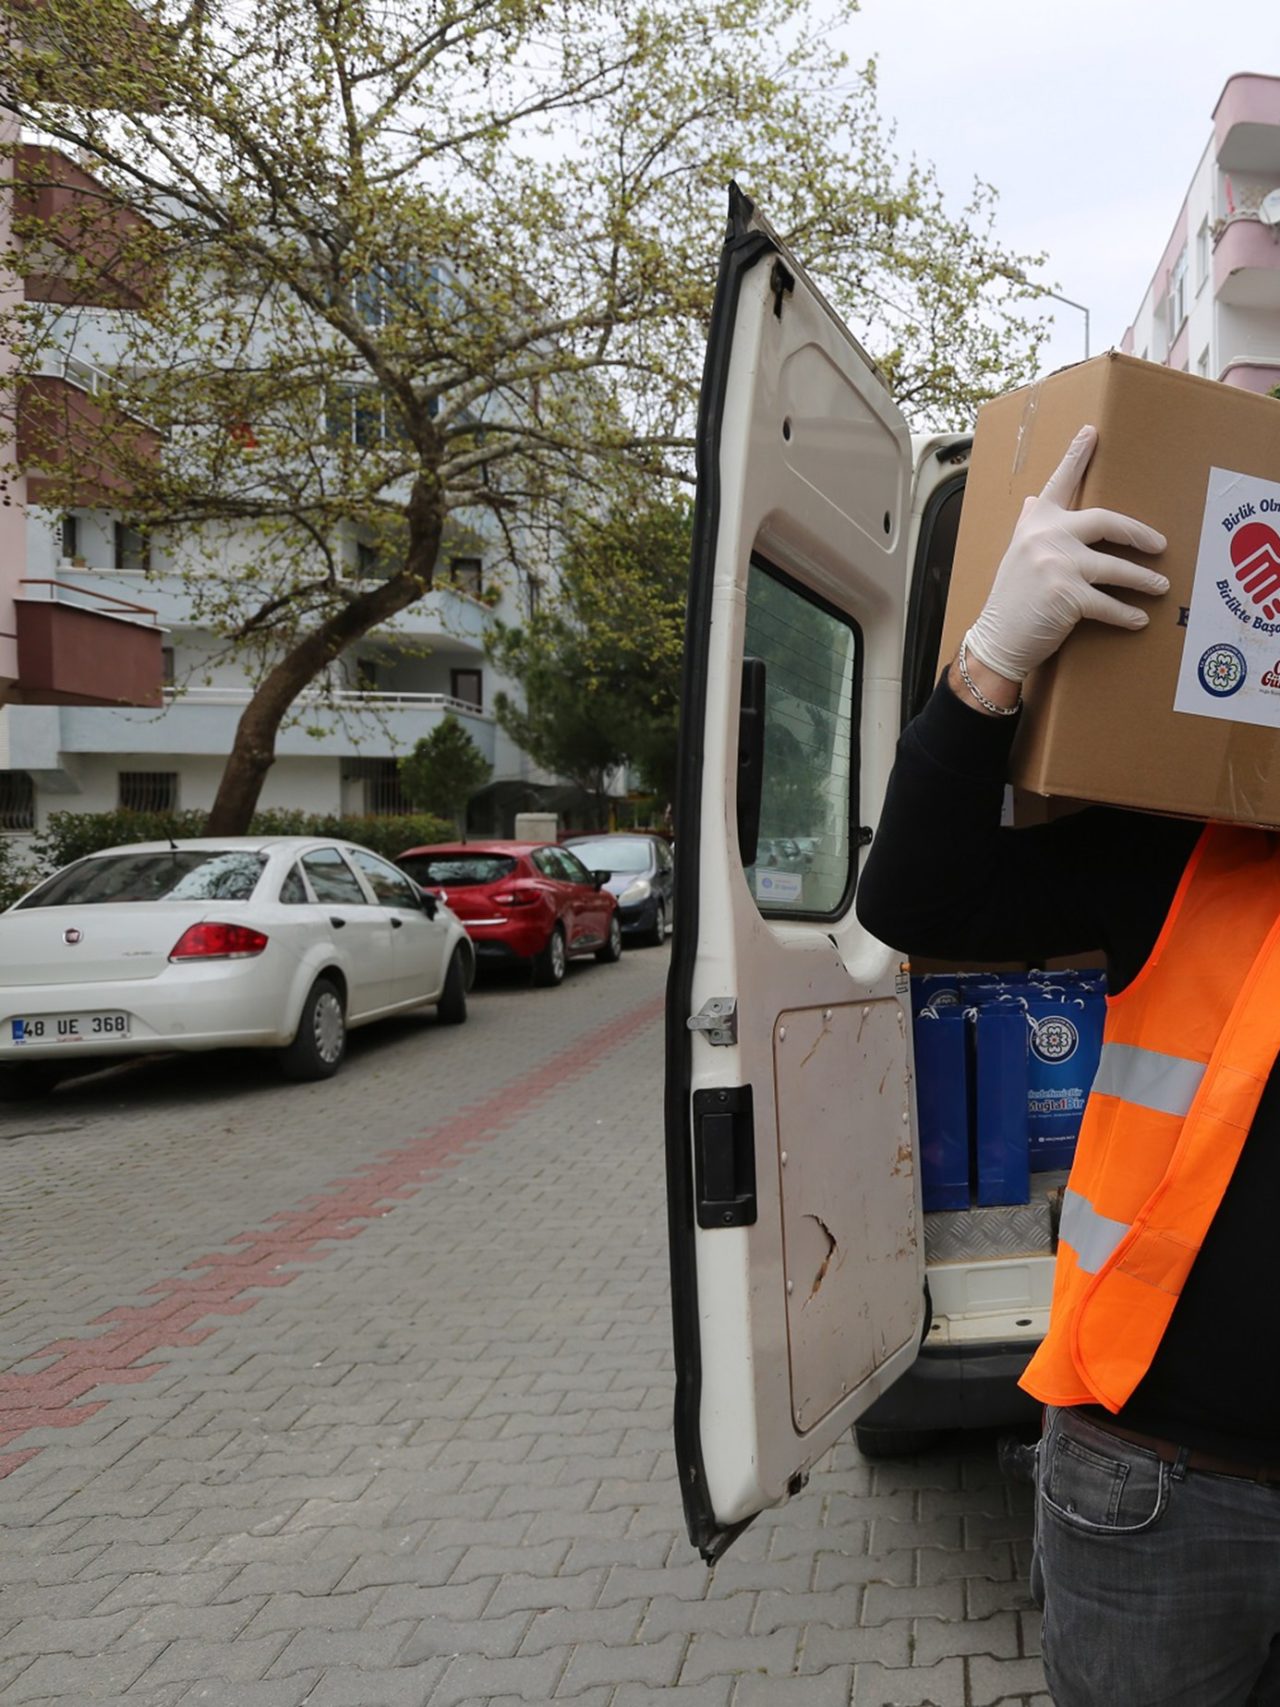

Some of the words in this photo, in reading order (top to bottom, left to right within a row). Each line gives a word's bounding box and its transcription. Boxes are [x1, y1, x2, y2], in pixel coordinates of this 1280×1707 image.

[1222, 502, 1256, 533] Birlik
[1216, 579, 1251, 624] Birlikte
[23, 1021, 45, 1037] 48
[58, 1019, 79, 1034] UE
[92, 1016, 125, 1033] 368
